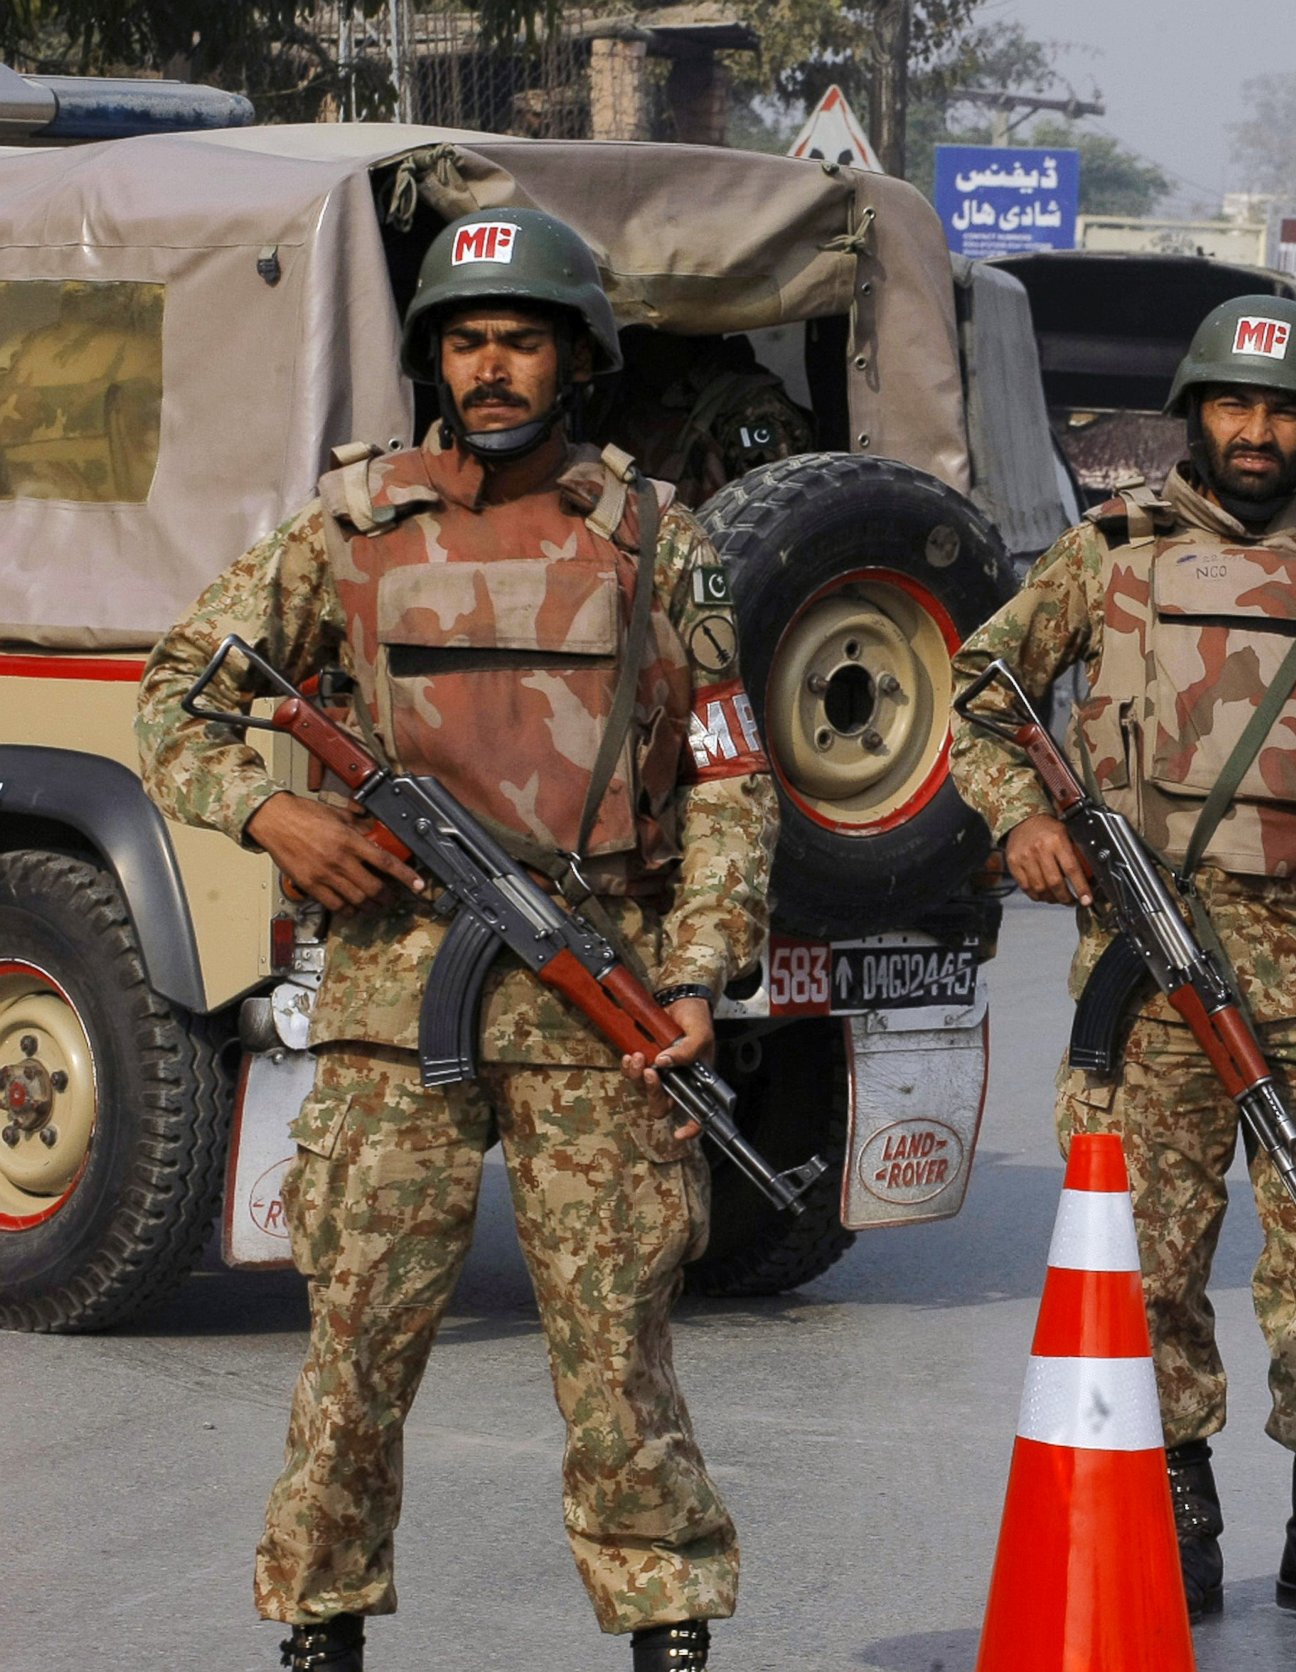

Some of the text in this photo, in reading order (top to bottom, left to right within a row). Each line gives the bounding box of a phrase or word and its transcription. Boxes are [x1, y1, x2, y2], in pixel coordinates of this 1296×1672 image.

[955, 156, 1058, 194] ڈیفنس
[998, 200, 1062, 231] شادی
[455, 226, 512, 262] MP
[1236, 321, 1287, 354] MP
[688, 693, 760, 769] MP
[771, 947, 829, 1005] 583
